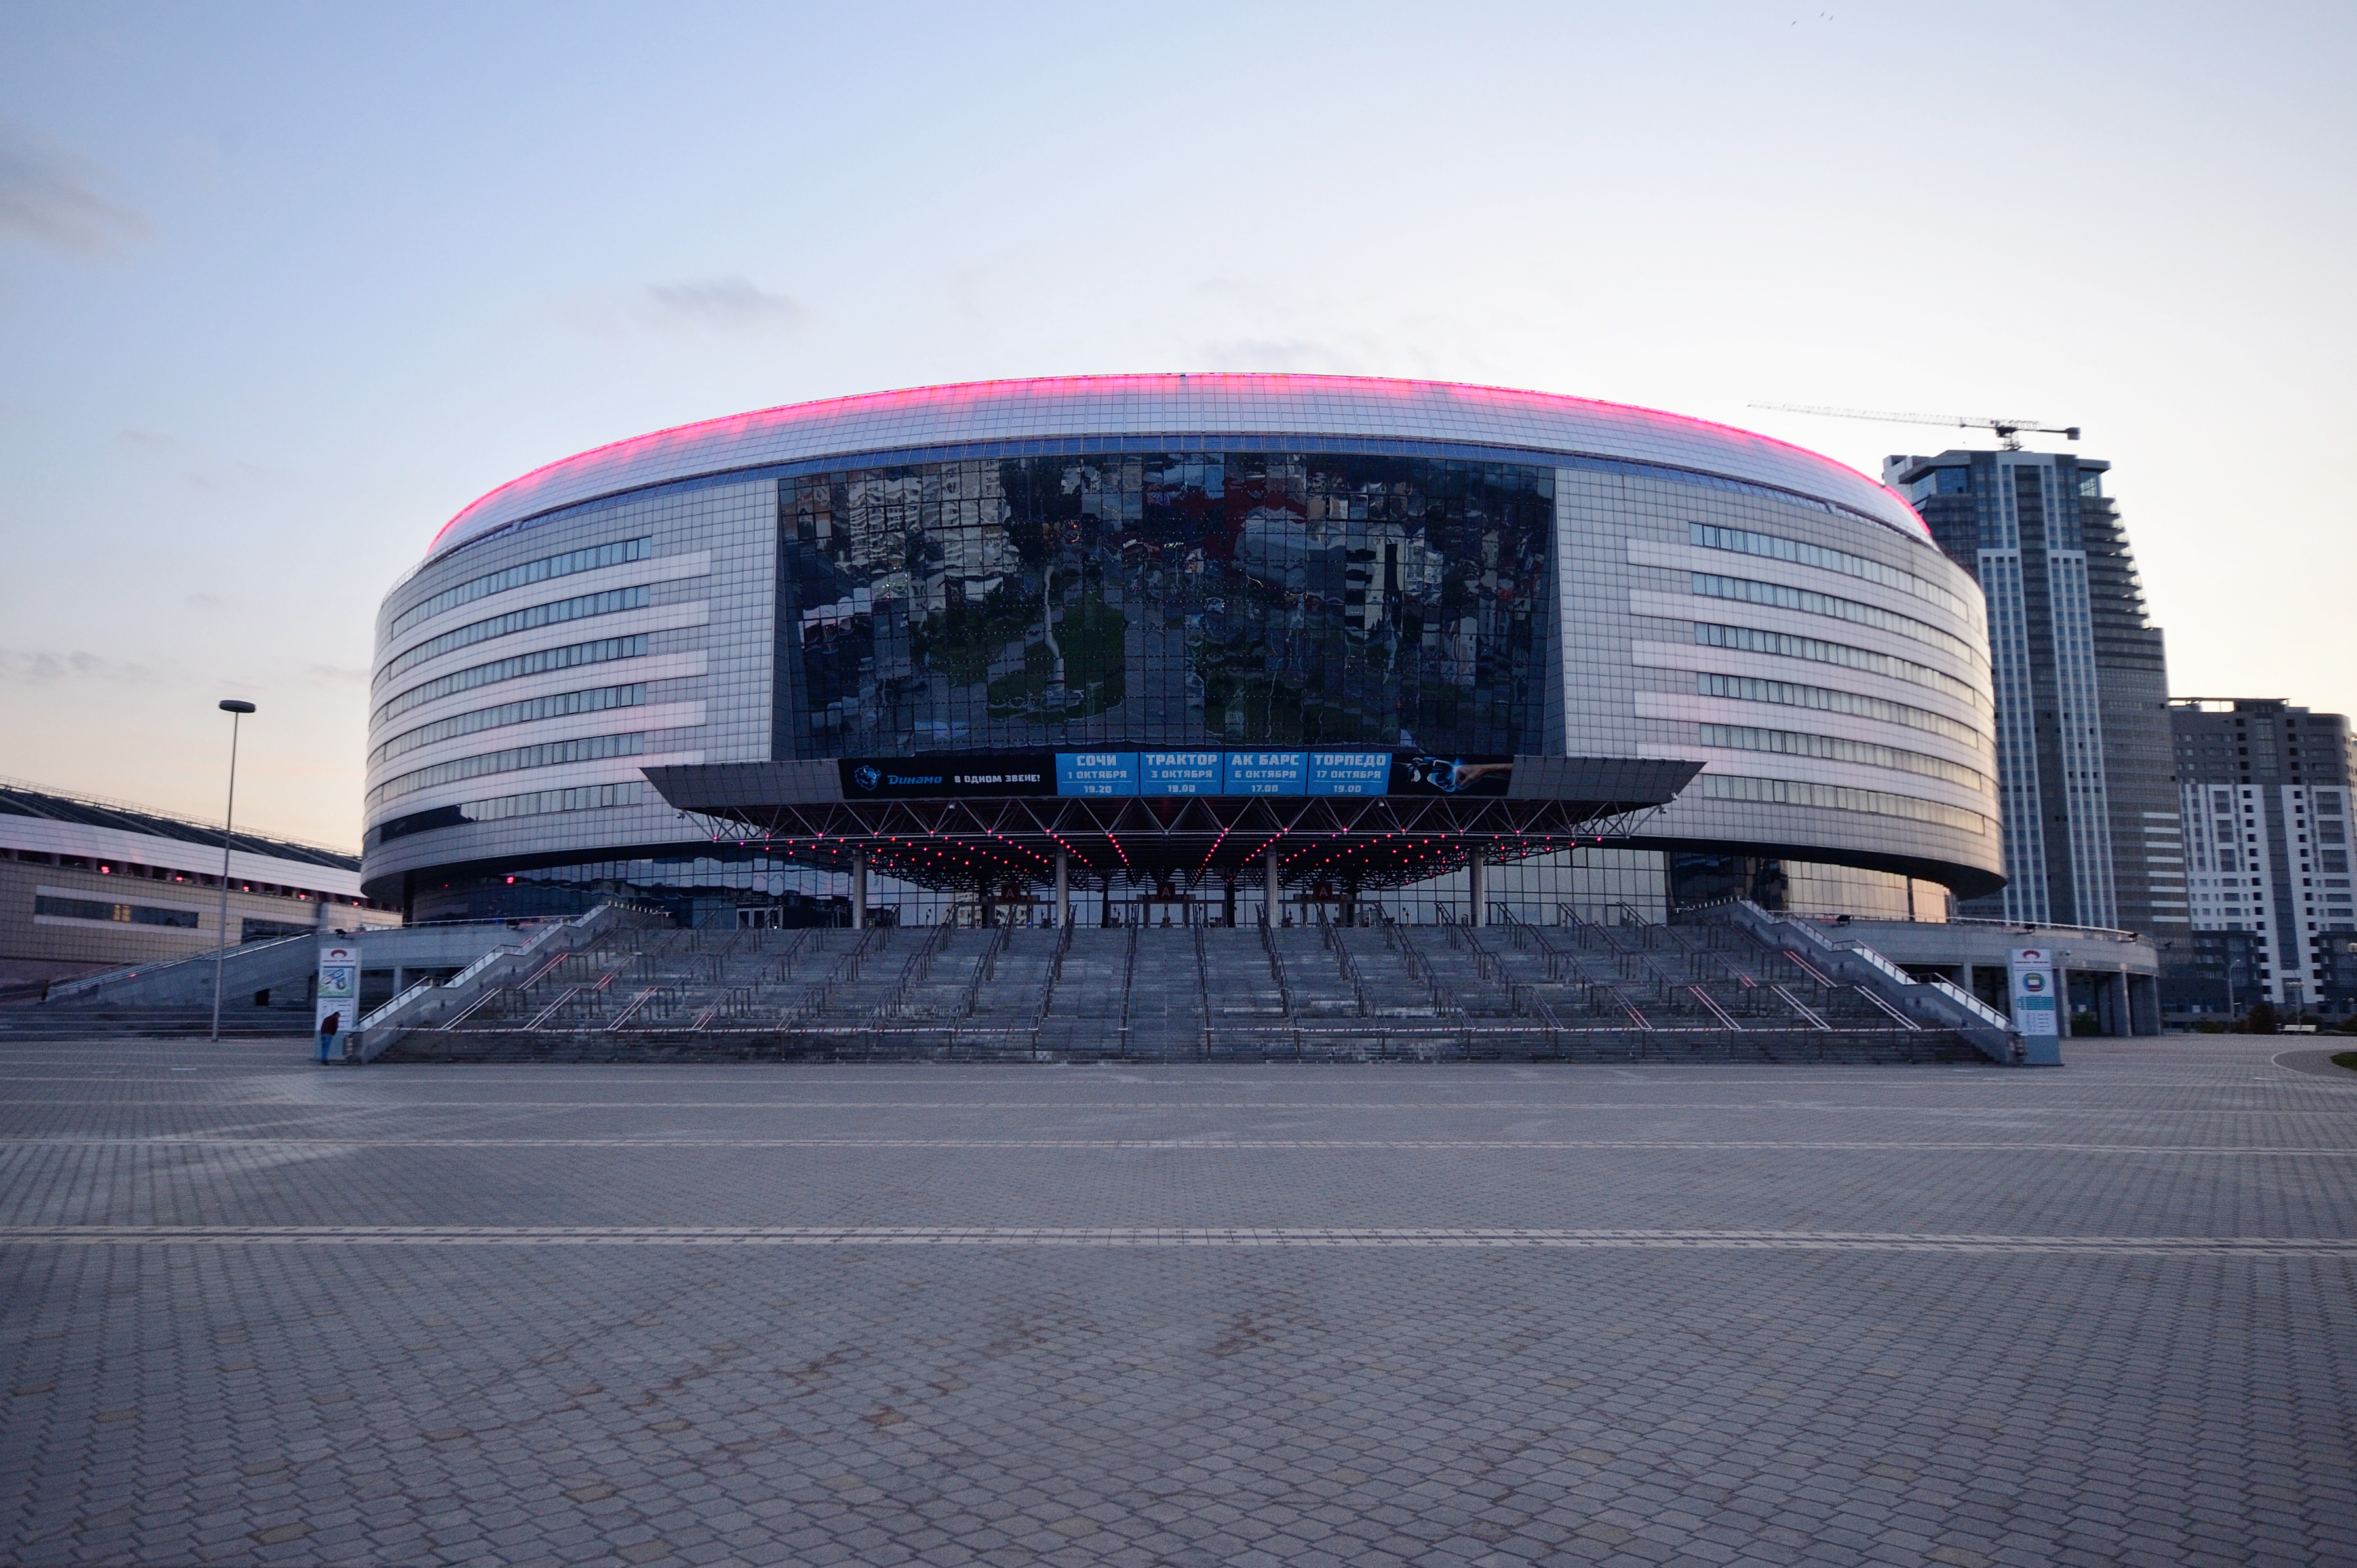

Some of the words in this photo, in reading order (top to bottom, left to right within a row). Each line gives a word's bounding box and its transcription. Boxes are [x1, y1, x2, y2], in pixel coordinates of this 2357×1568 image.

[1076, 755, 1117, 766] СОЧИ
[1146, 754, 1217, 765] ТРАКТОР
[1232, 754, 1253, 765] АК
[1259, 754, 1299, 765] БАРС
[1314, 754, 1386, 767] ТОРПЕДО
[964, 775, 1002, 784] ОДНОМ
[1083, 785, 1112, 794] 19.20
[1005, 887, 1015, 898] A
[1161, 887, 1171, 897] A
[1319, 887, 1329, 896] A
